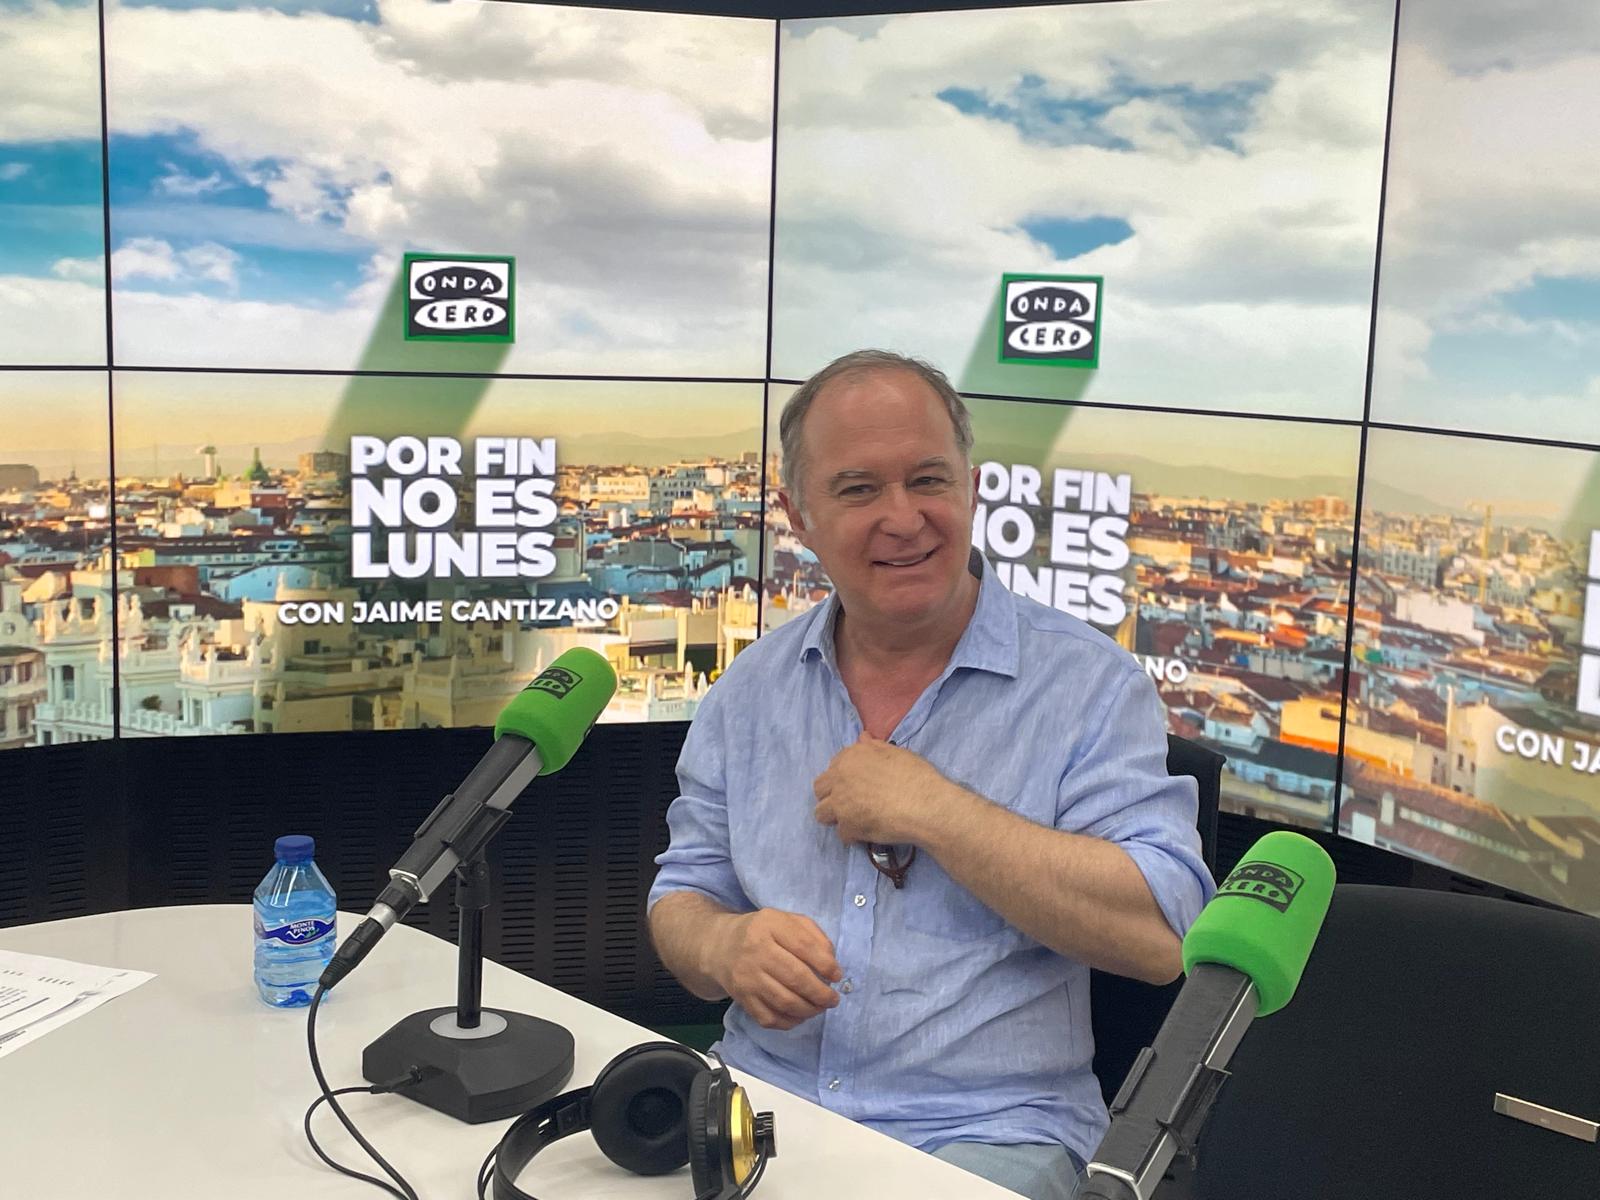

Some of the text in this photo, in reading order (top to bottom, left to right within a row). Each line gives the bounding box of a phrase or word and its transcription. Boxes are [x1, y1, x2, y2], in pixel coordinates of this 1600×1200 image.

[422, 274, 495, 293] ONDA
[427, 305, 495, 324] CERO
[1016, 296, 1083, 314] ONDA
[1019, 327, 1082, 347] CERO
[350, 436, 557, 476] POR FIN
[351, 478, 558, 528] NO ES
[978, 461, 1132, 515] OR FIN
[351, 531, 558, 579] LUNES
[1051, 512, 1131, 572] ES
[278, 597, 620, 625] CON JAIME CANTIZANO
[996, 563, 1127, 627] NES
[1495, 724, 1565, 767] CON
[1232, 868, 1287, 885] ONDA
